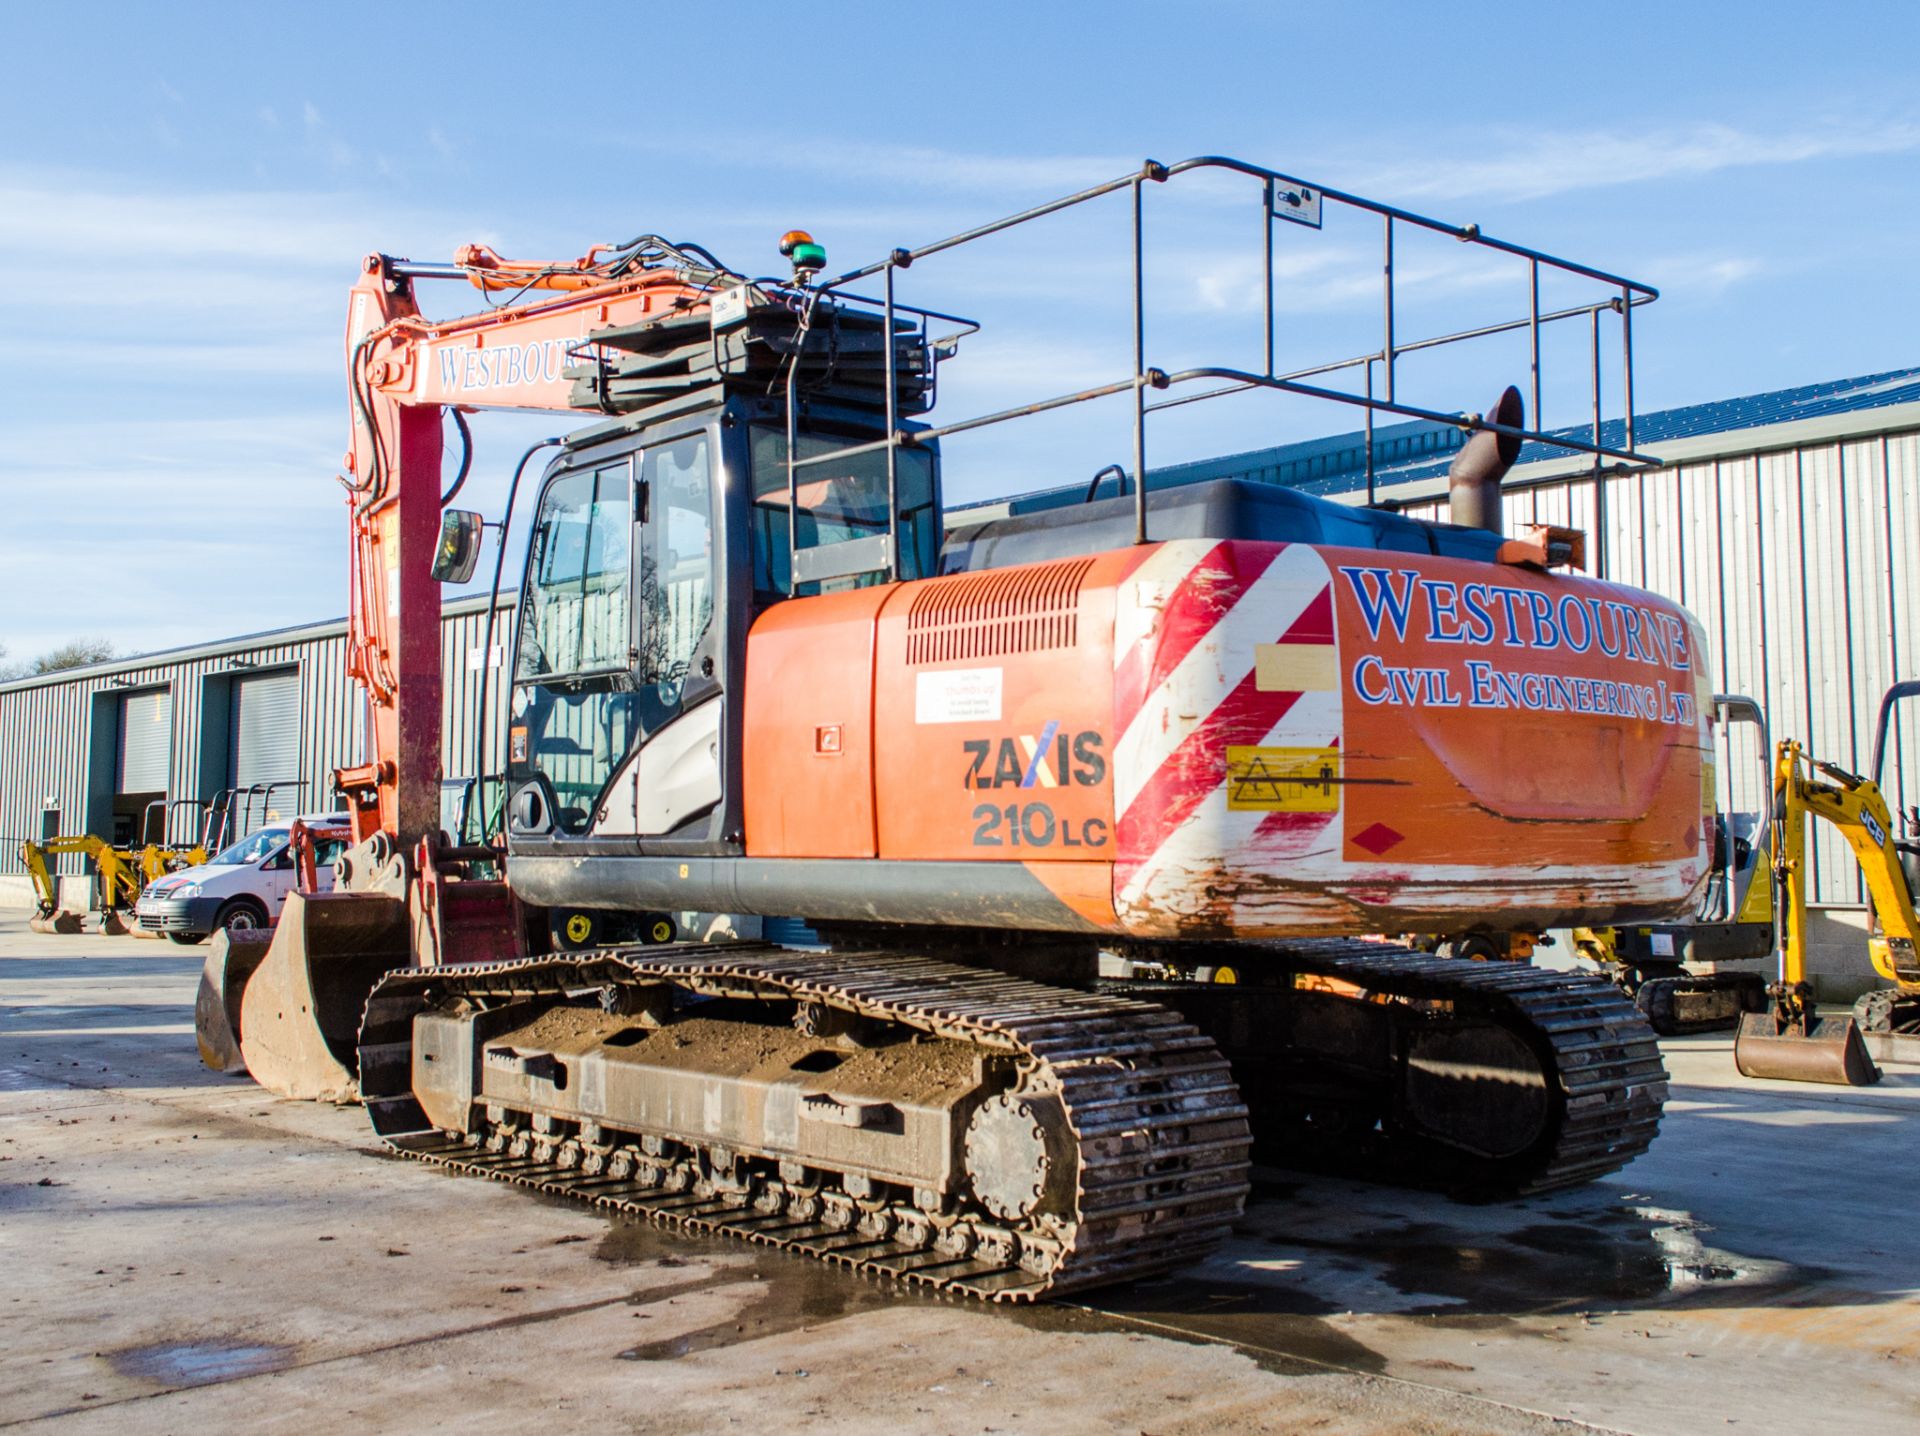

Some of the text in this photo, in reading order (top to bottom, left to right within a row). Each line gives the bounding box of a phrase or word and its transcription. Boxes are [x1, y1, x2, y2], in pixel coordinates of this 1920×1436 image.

[1339, 565, 1691, 671] WESTBOURNE
[1353, 655, 1461, 706] CIVIL
[1464, 660, 1656, 720] ENGINEERING
[1657, 680, 1695, 726] LTD
[963, 720, 1106, 789] ZAXIS
[1859, 810, 1886, 847] JCB
